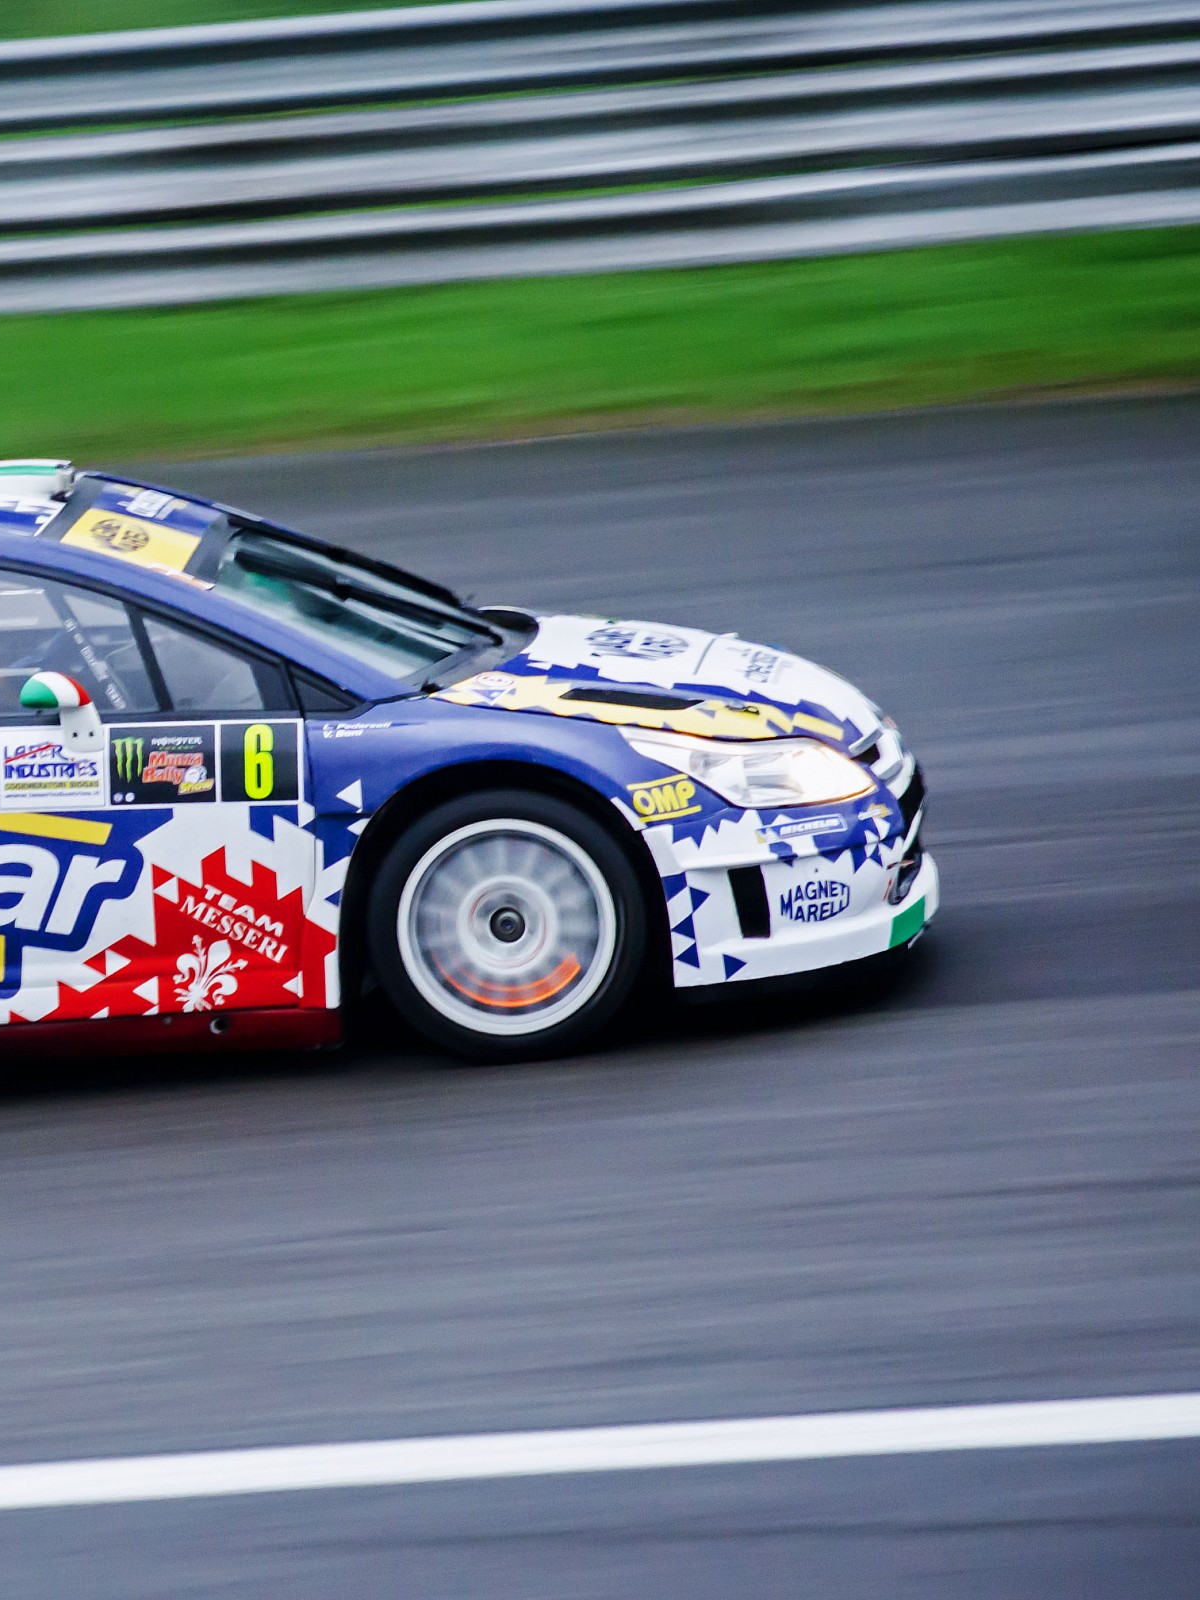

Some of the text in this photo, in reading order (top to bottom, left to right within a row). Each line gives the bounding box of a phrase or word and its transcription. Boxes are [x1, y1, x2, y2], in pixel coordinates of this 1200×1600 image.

[4, 742, 69, 762] LASER
[244, 723, 274, 800] 6
[4, 759, 98, 779] INDUSTRIES
[142, 766, 186, 786] Rally
[631, 779, 697, 816] OMP
[779, 817, 841, 836] MICHELIN
[204, 884, 284, 938] TEAM
[180, 895, 289, 964] MESSERI
